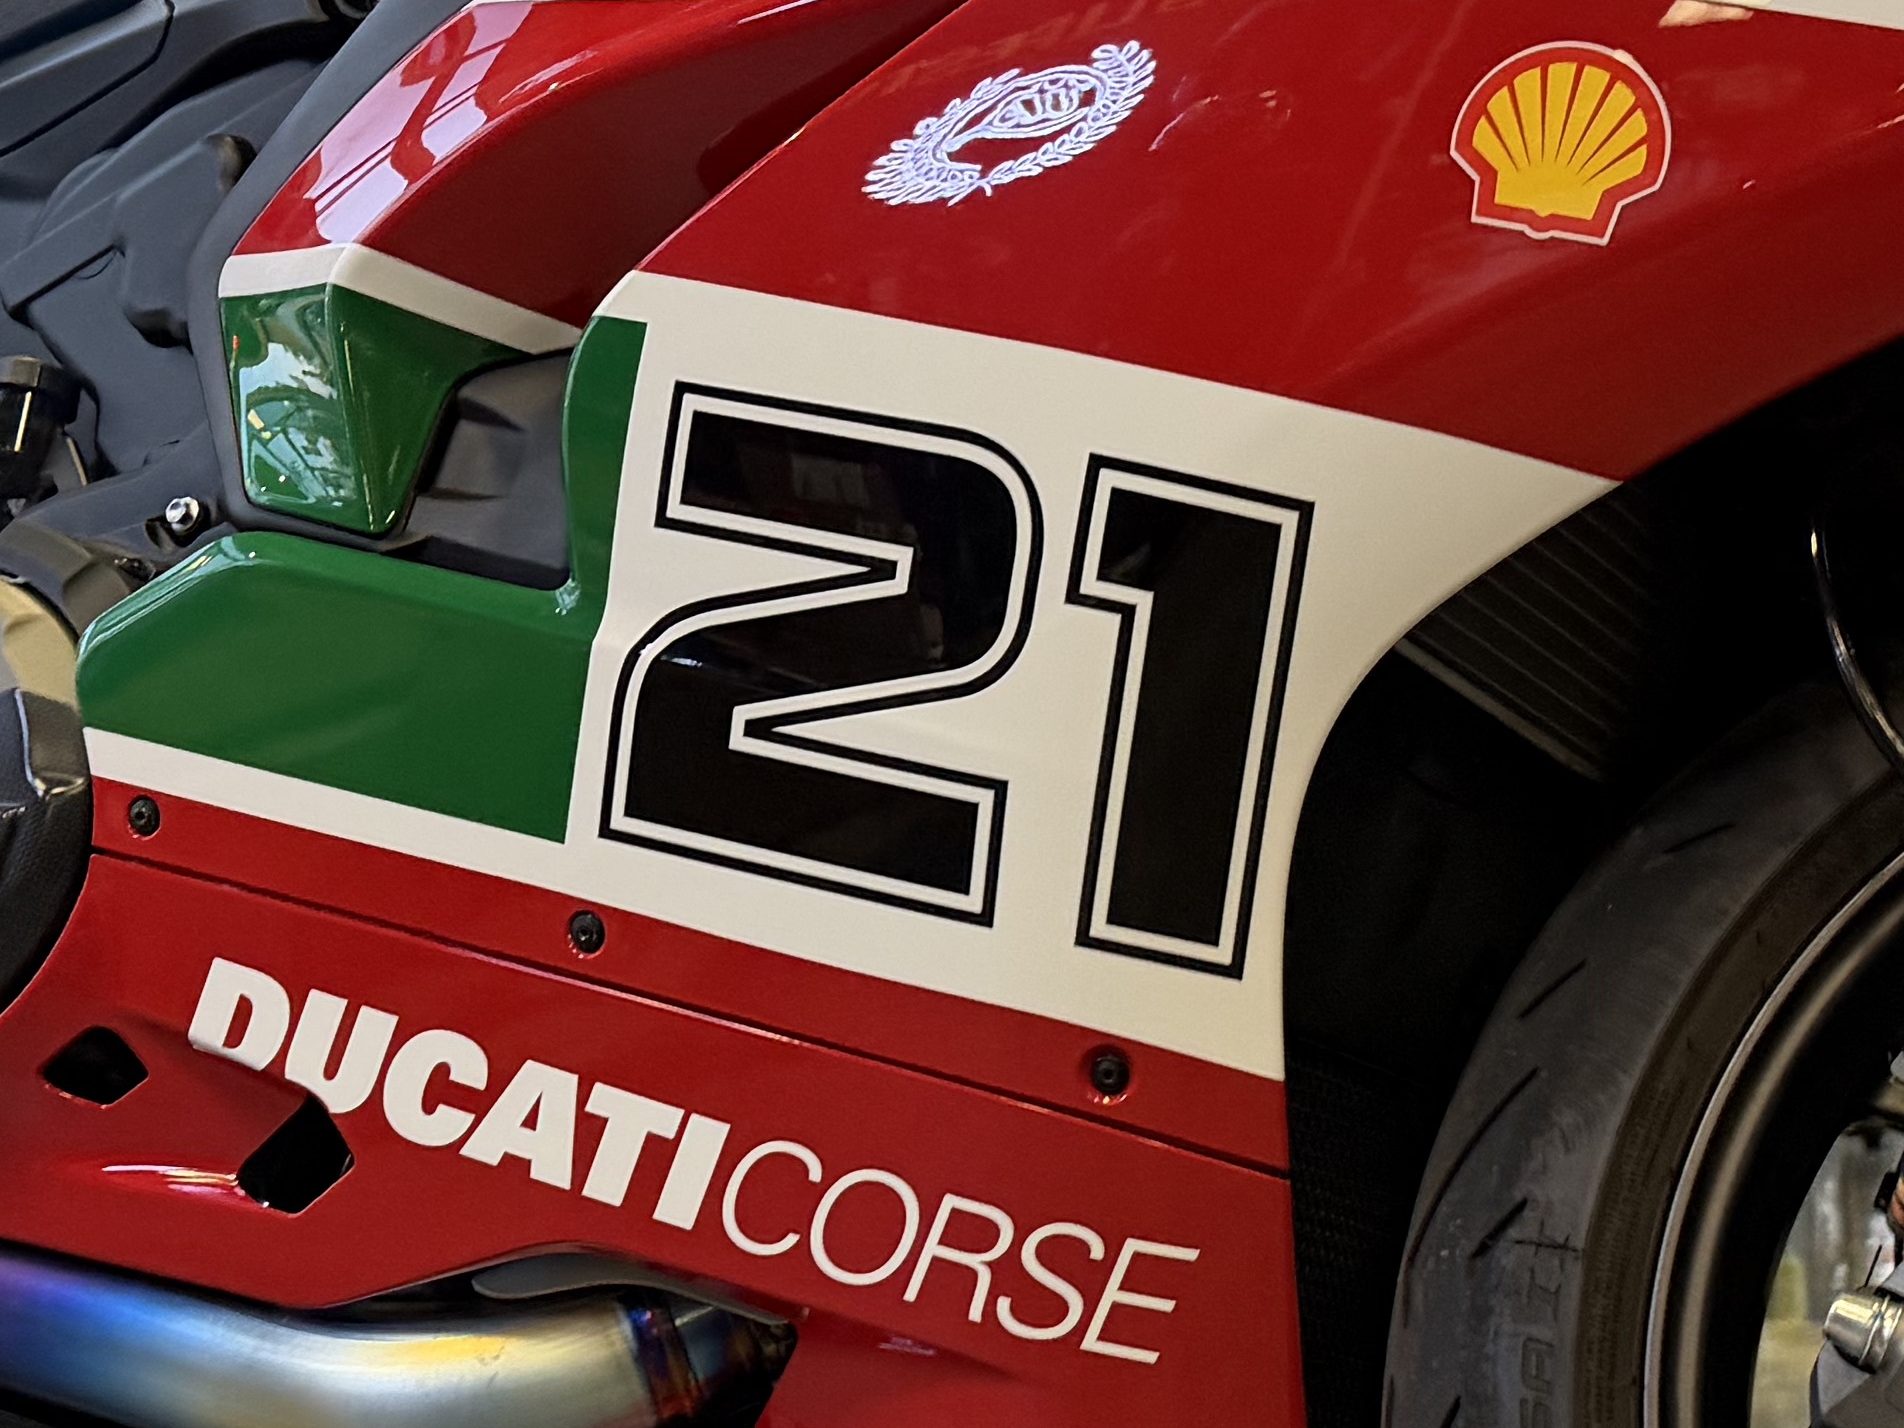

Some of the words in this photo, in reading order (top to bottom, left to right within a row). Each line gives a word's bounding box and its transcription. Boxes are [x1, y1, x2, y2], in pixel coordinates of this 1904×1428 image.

[598, 380, 1316, 982] 21
[187, 957, 732, 1231] DUCATI
[720, 1139, 1201, 1366] CORSE
